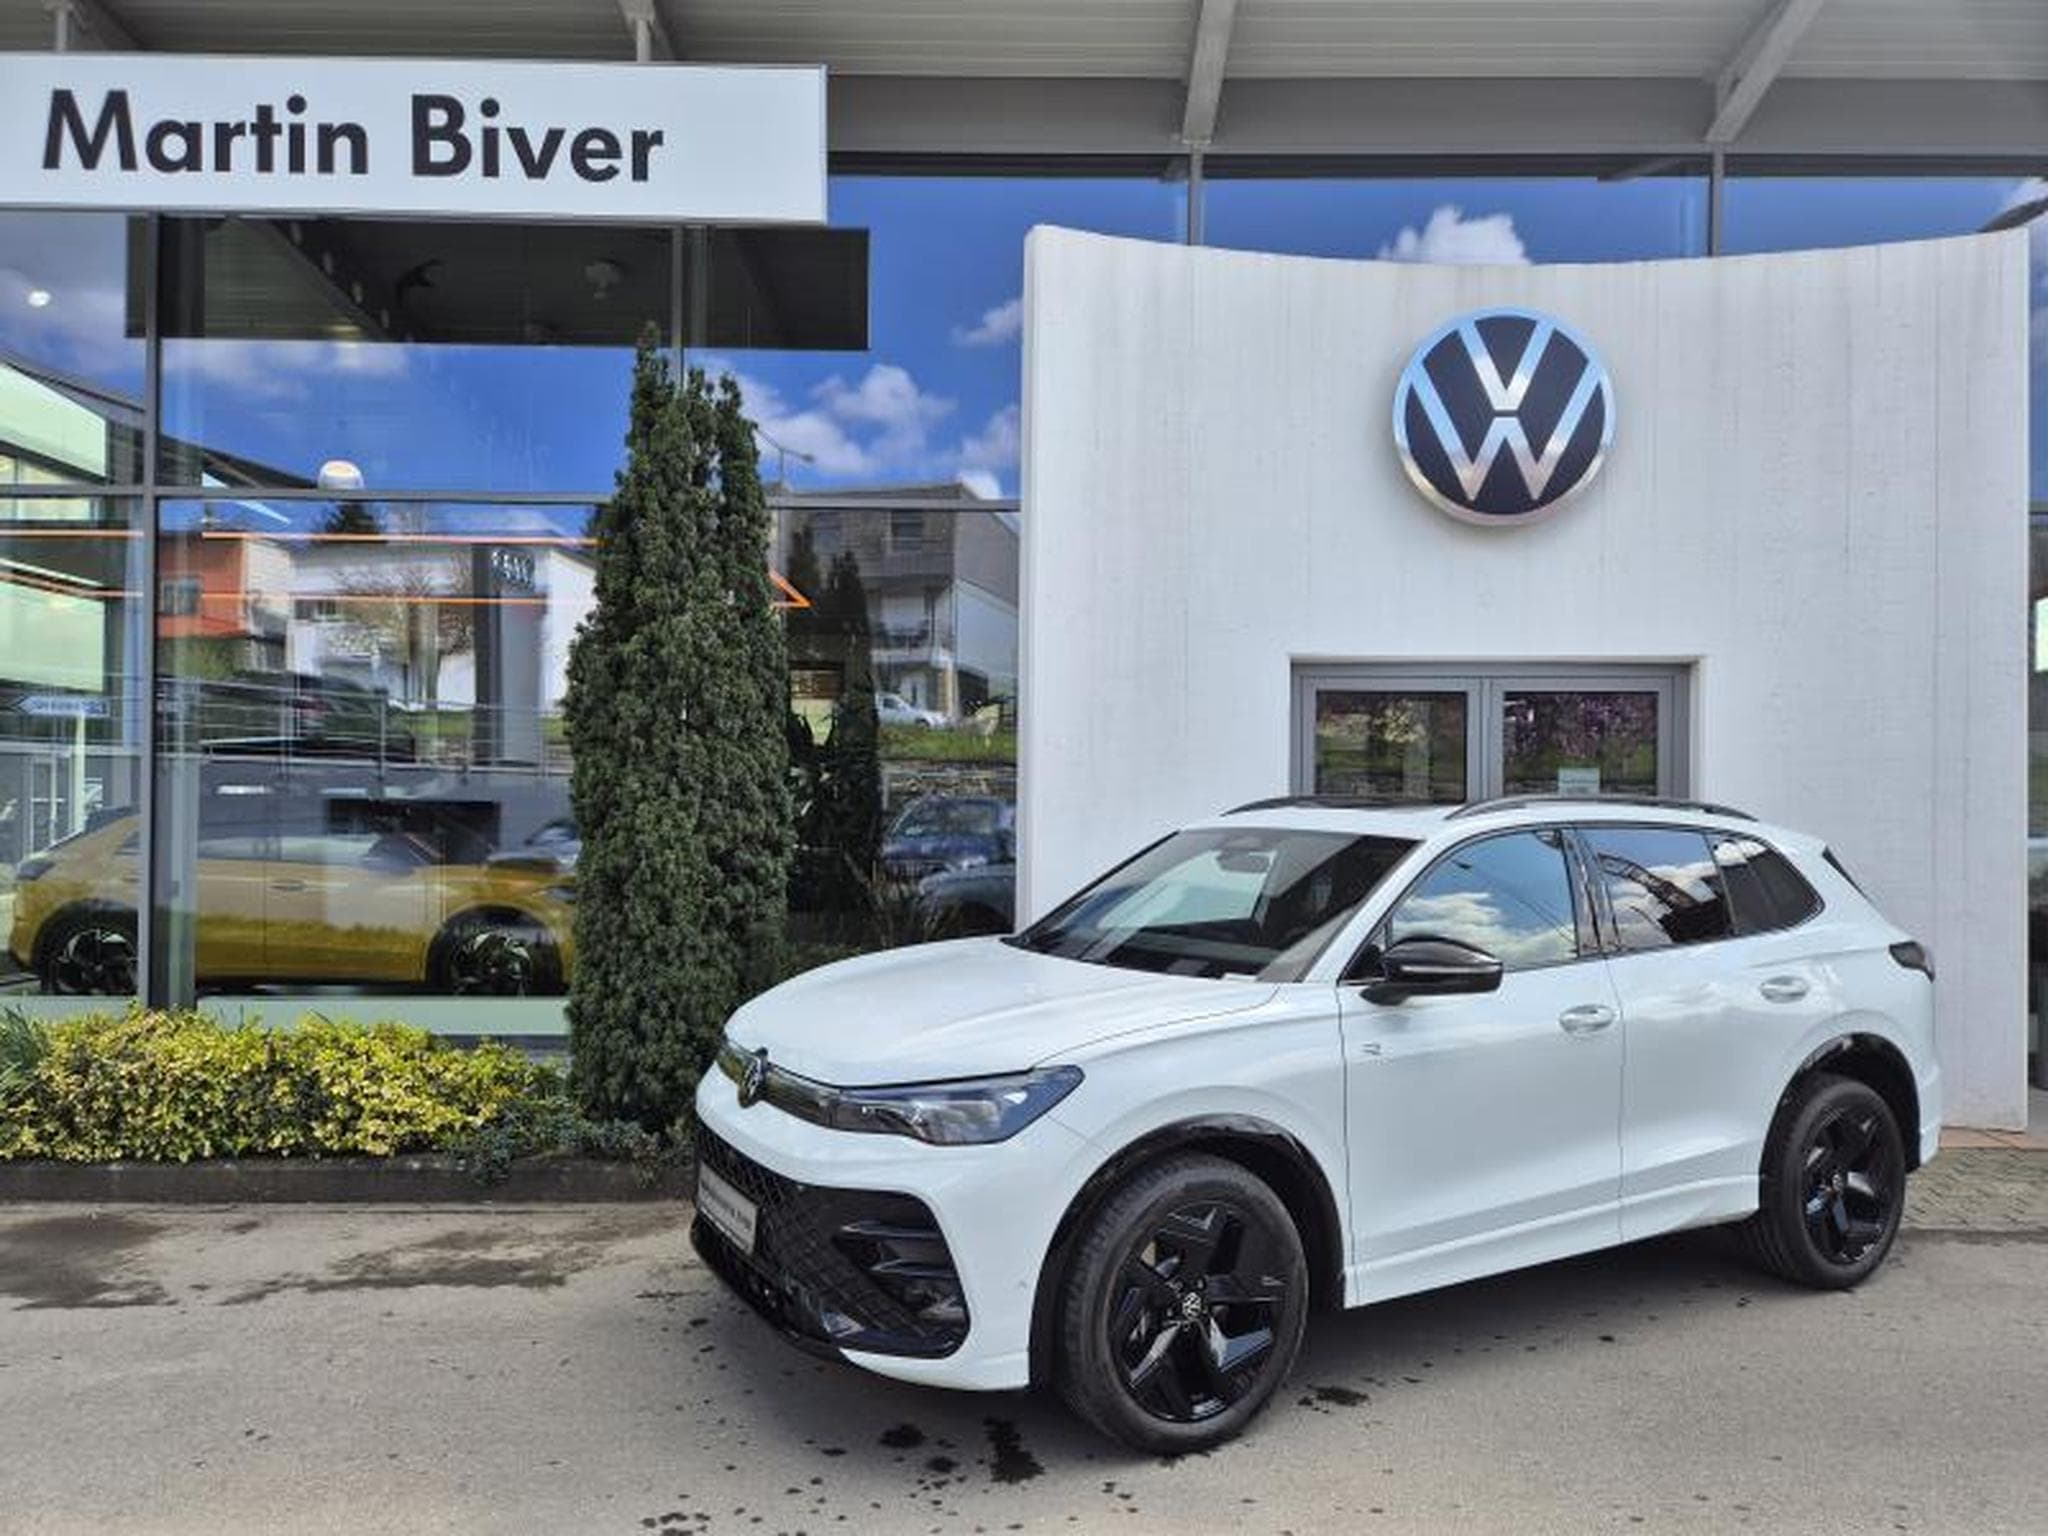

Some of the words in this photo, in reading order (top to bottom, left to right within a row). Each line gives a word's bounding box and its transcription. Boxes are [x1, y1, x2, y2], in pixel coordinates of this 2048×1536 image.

[43, 88, 368, 175] Martin
[410, 94, 664, 183] Biver
[1402, 312, 1607, 508] VW
